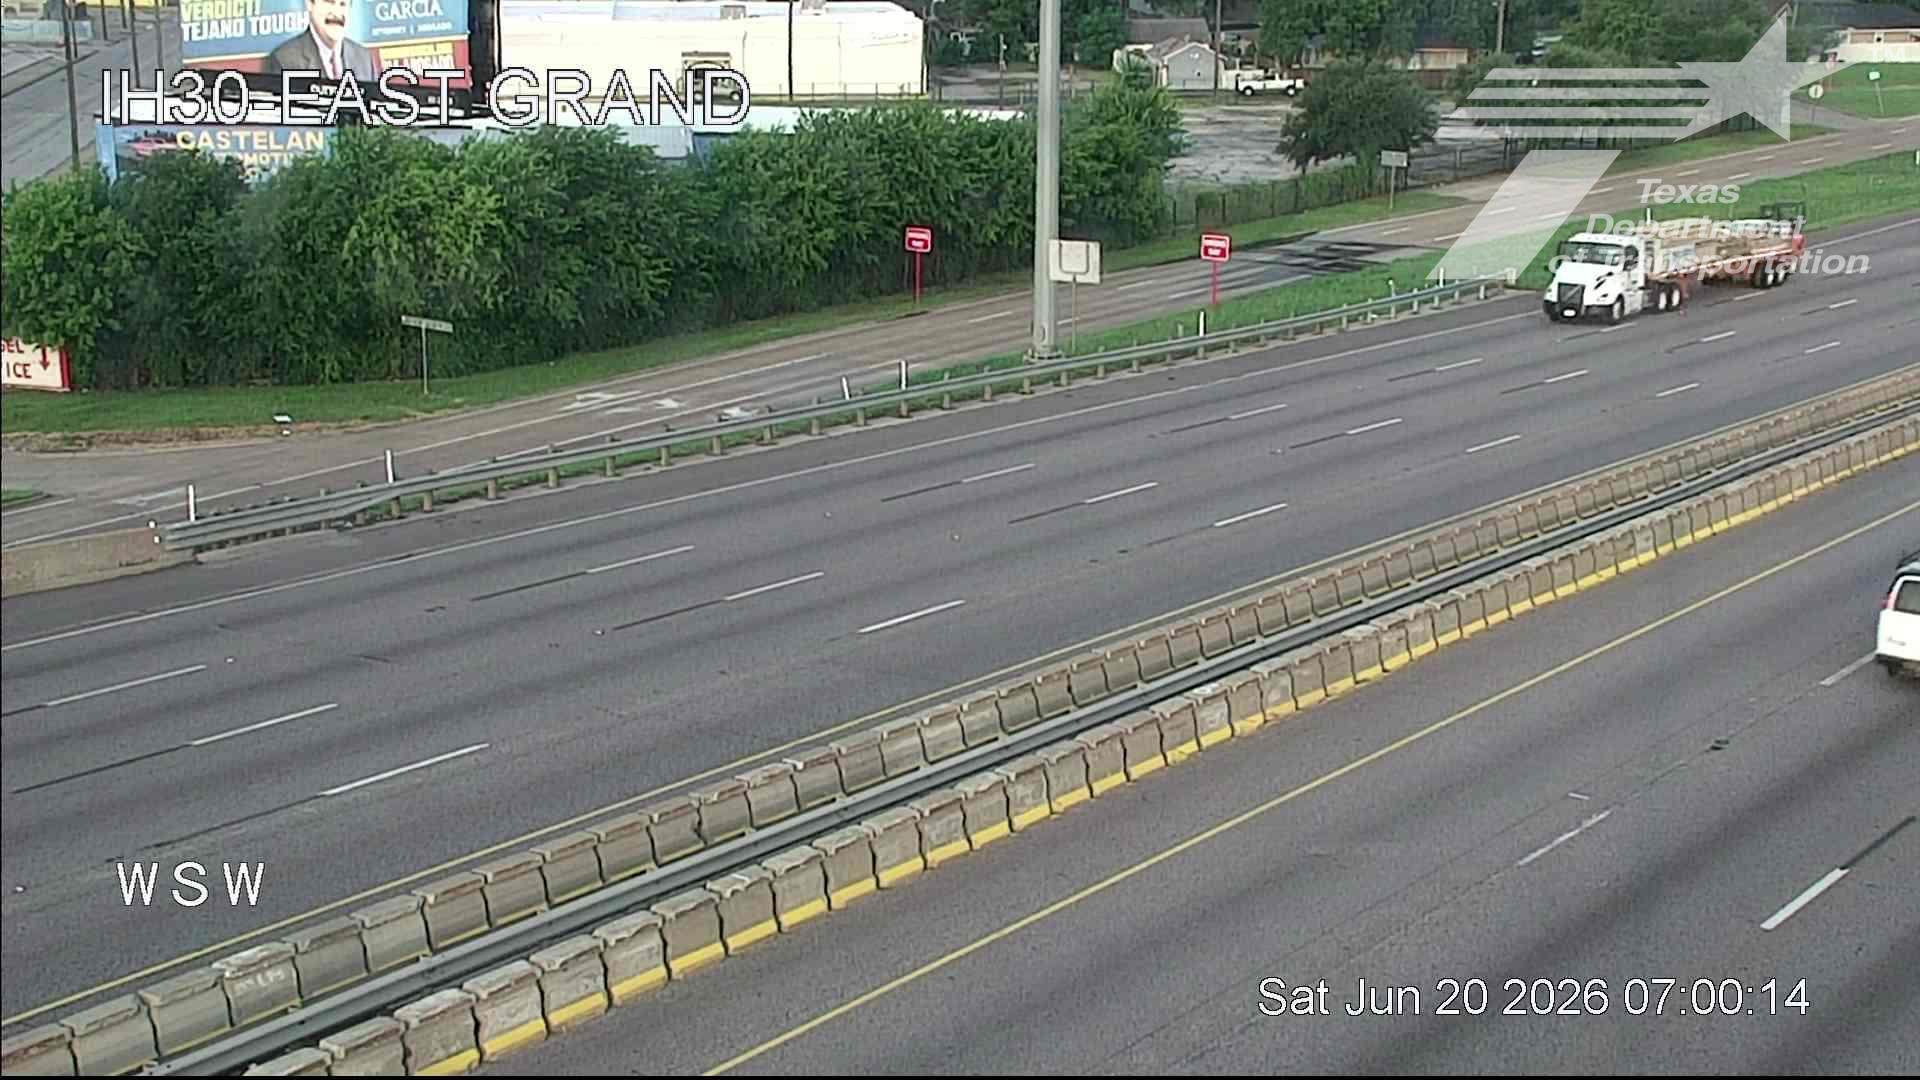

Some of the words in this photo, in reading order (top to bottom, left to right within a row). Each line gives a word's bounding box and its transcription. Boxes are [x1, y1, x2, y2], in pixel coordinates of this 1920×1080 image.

[181, 16, 246, 42] TEJANO
[247, 11, 310, 36] TOUGH
[176, 130, 325, 151] CASTELAN
